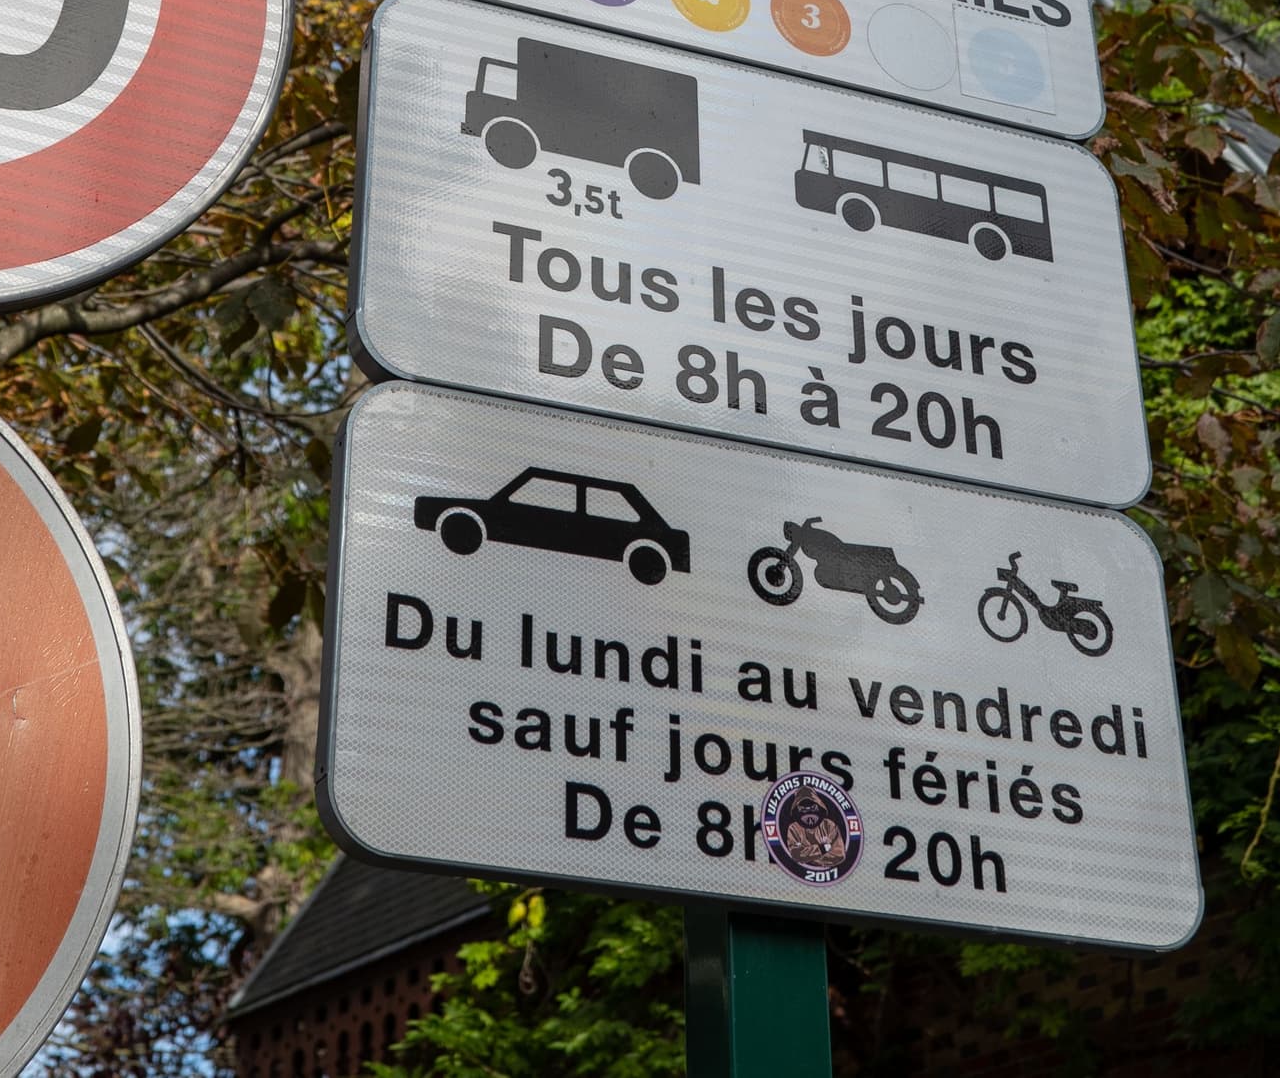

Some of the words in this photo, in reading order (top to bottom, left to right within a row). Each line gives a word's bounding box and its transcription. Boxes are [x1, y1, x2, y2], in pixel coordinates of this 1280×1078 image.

[800, 3, 821, 29] 3
[546, 168, 624, 220] 3,5t
[492, 221, 680, 314] Tous
[710, 265, 822, 343] les
[848, 294, 1039, 386] jours
[537, 313, 646, 391] De
[675, 343, 769, 416] 8h
[799, 366, 842, 430] à
[869, 381, 1005, 461] 20h
[385, 591, 484, 661] Du
[521, 613, 704, 695] lundi
[737, 658, 819, 712] au
[848, 673, 1150, 760] vendredi
[468, 698, 635, 764] sauf
[662, 712, 856, 793] jours
[883, 746, 1084, 825] fériés
[767, 777, 801, 815] ULTRAS
[803, 776, 851, 811] PANAME
[565, 781, 663, 850] De
[695, 799, 777, 864] 8h
[883, 825, 1008, 895] 20h
[805, 868, 838, 882] 2017
